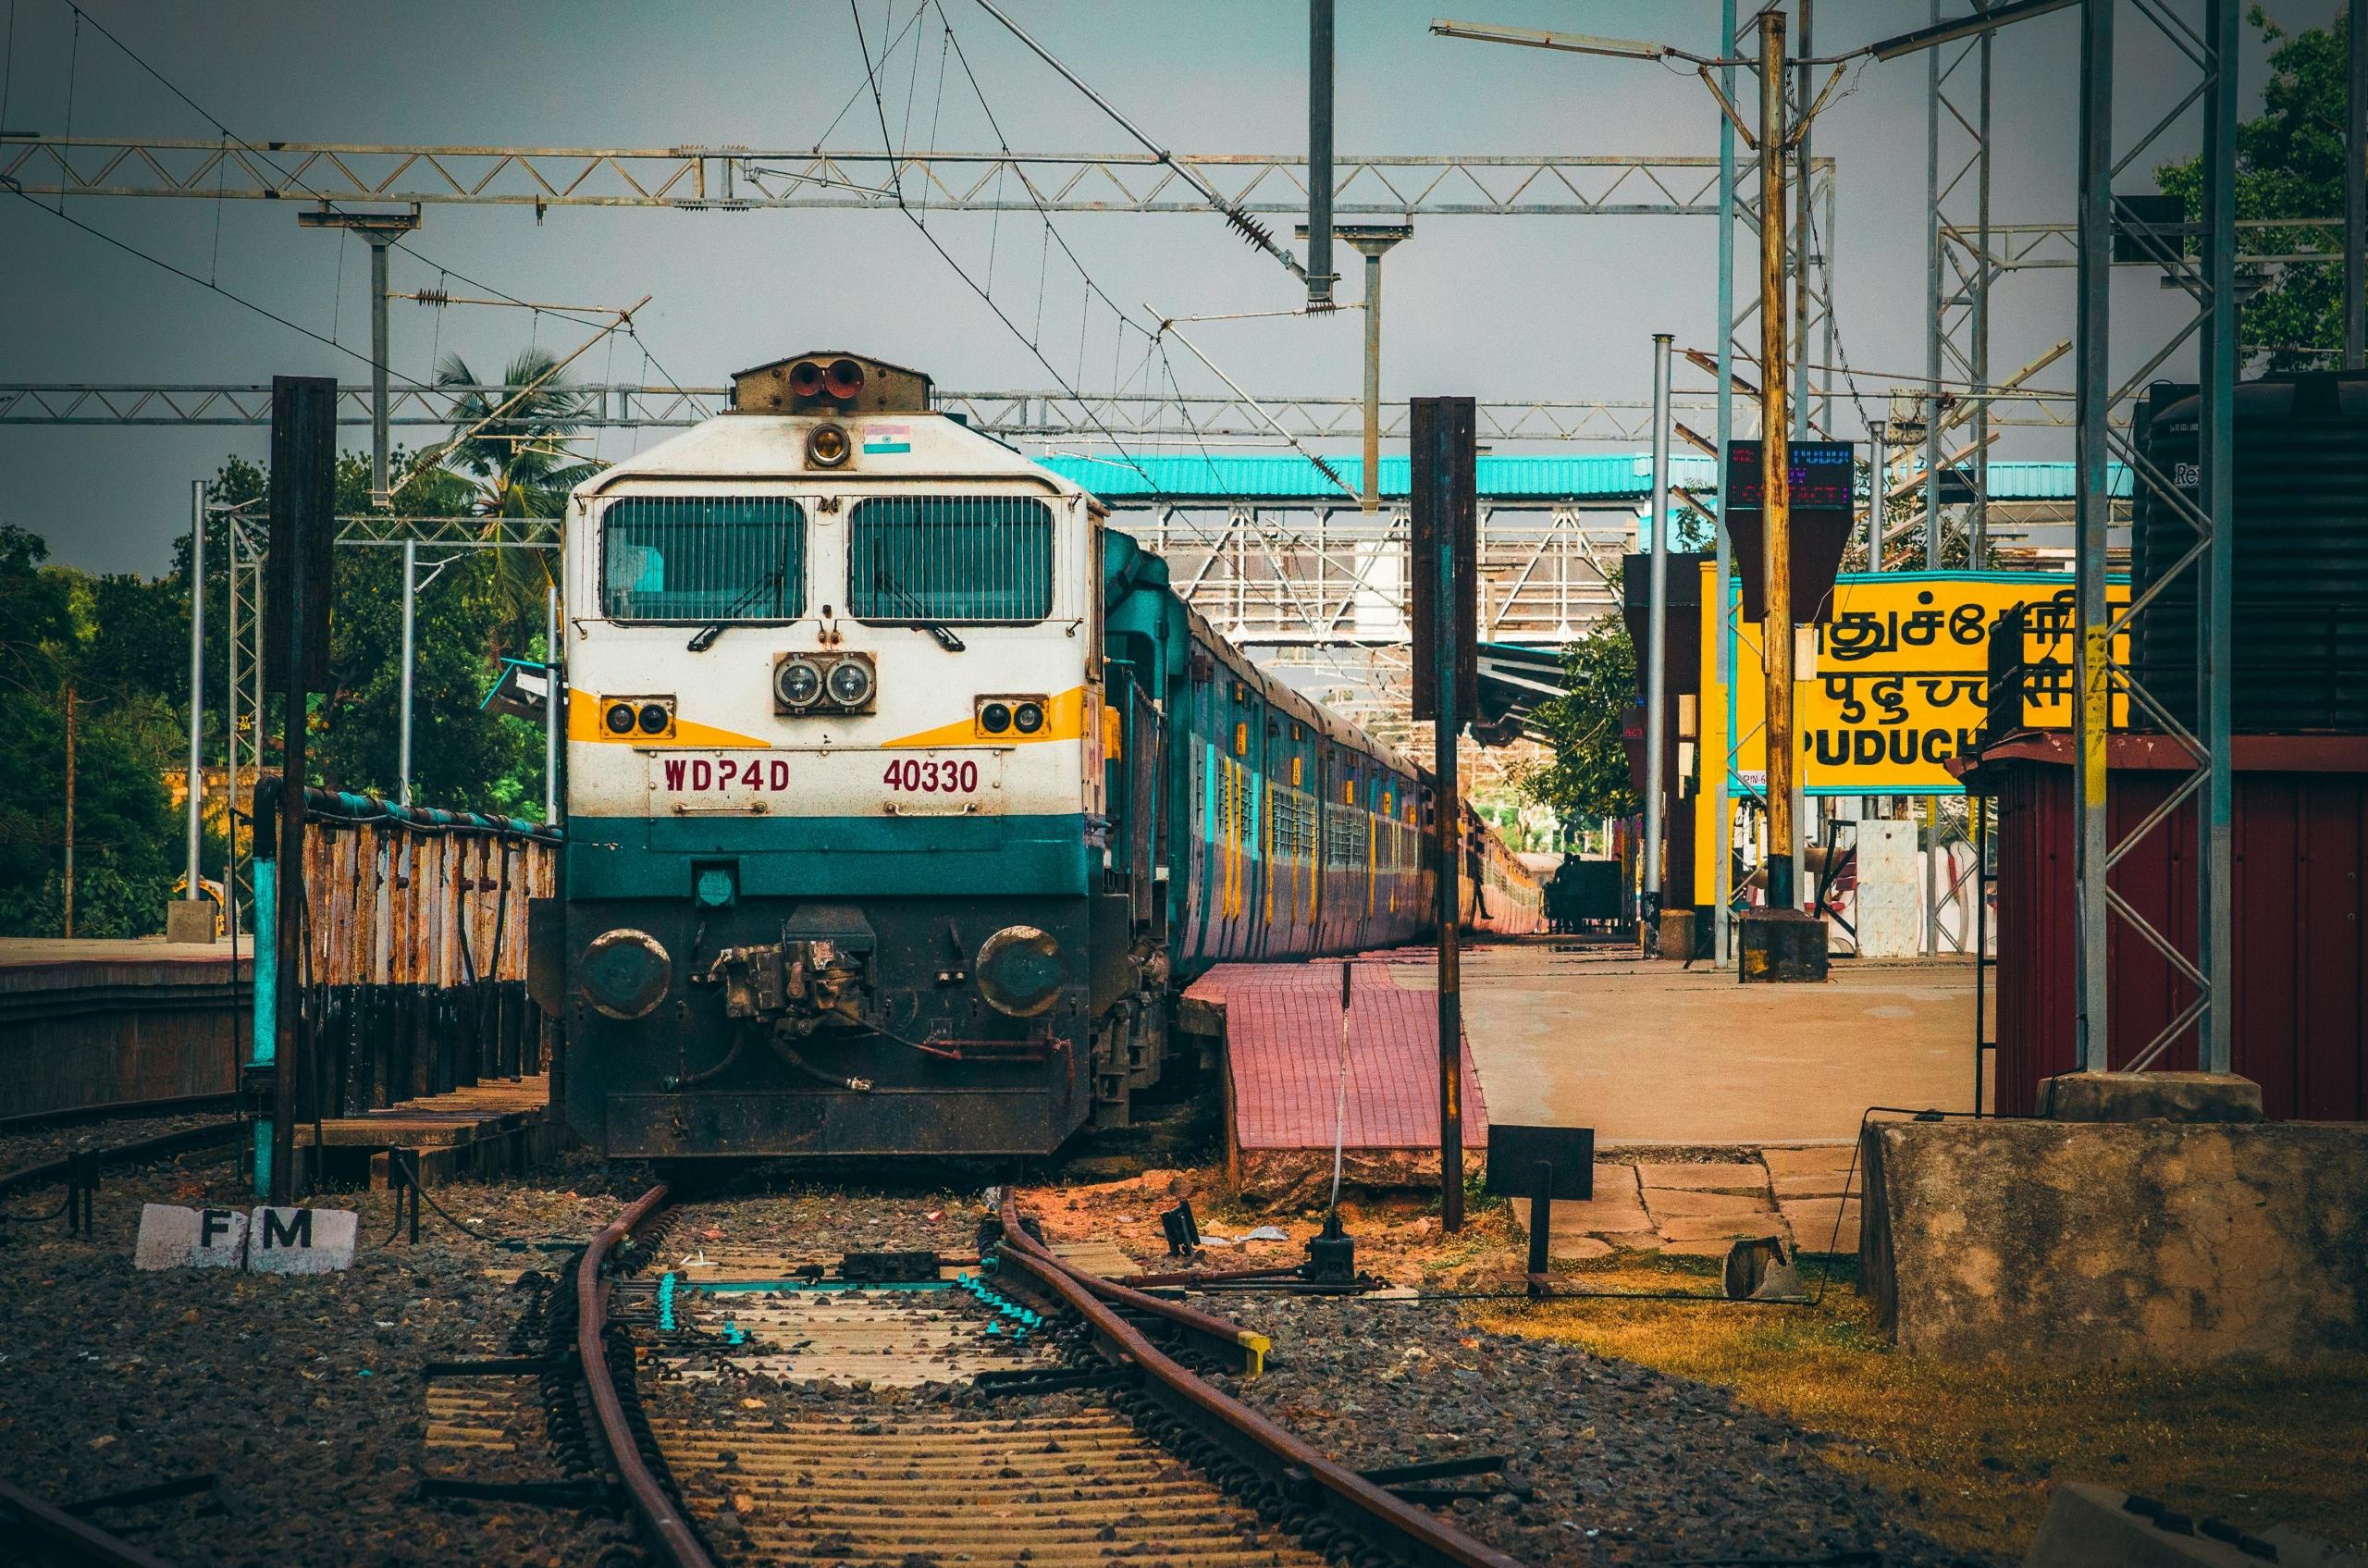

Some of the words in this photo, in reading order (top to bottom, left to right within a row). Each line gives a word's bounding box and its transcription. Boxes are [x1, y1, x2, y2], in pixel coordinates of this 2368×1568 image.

[2175, 463, 2200, 488] Re
[665, 759, 789, 791] WDP4D
[883, 759, 978, 792] 40330
